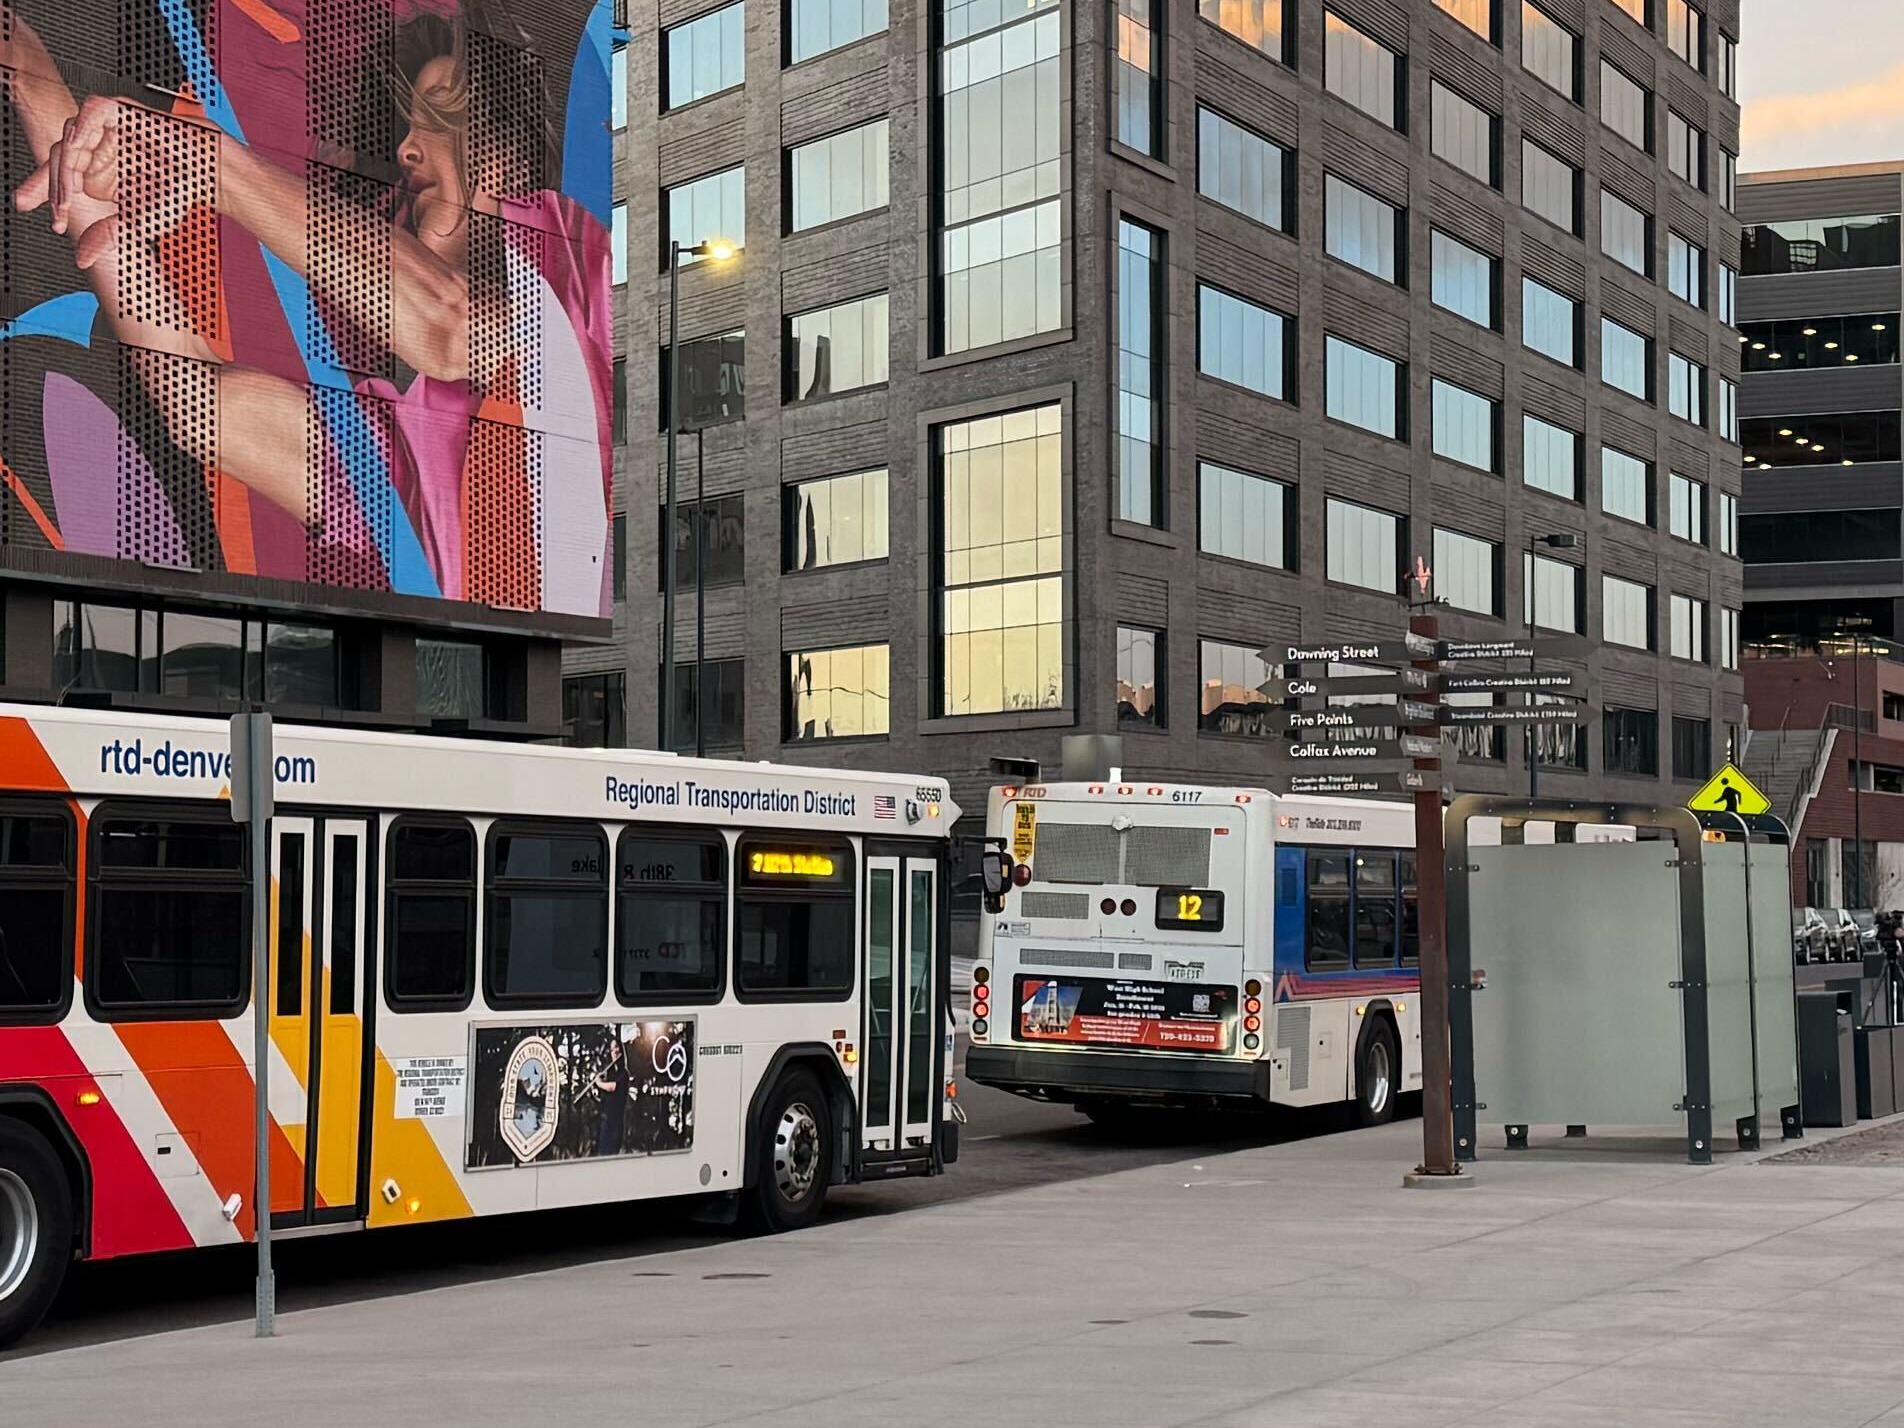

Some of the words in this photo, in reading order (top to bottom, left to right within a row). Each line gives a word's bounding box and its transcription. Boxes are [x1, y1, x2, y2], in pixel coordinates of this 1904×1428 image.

[1287, 647, 1340, 661] Downing
[1342, 646, 1380, 658] Street
[1287, 682, 1317, 694] Cole
[1290, 714, 1315, 727] Five
[1316, 713, 1354, 726] Points
[1289, 743, 1331, 758] Colfax
[1332, 745, 1378, 757] Avenue
[100, 738, 316, 784] rtd-denvom
[606, 776, 680, 810] Regional
[685, 781, 799, 816] Transportation
[804, 789, 857, 816] District
[1172, 791, 1203, 803] 6117
[1177, 894, 1203, 921] 12
